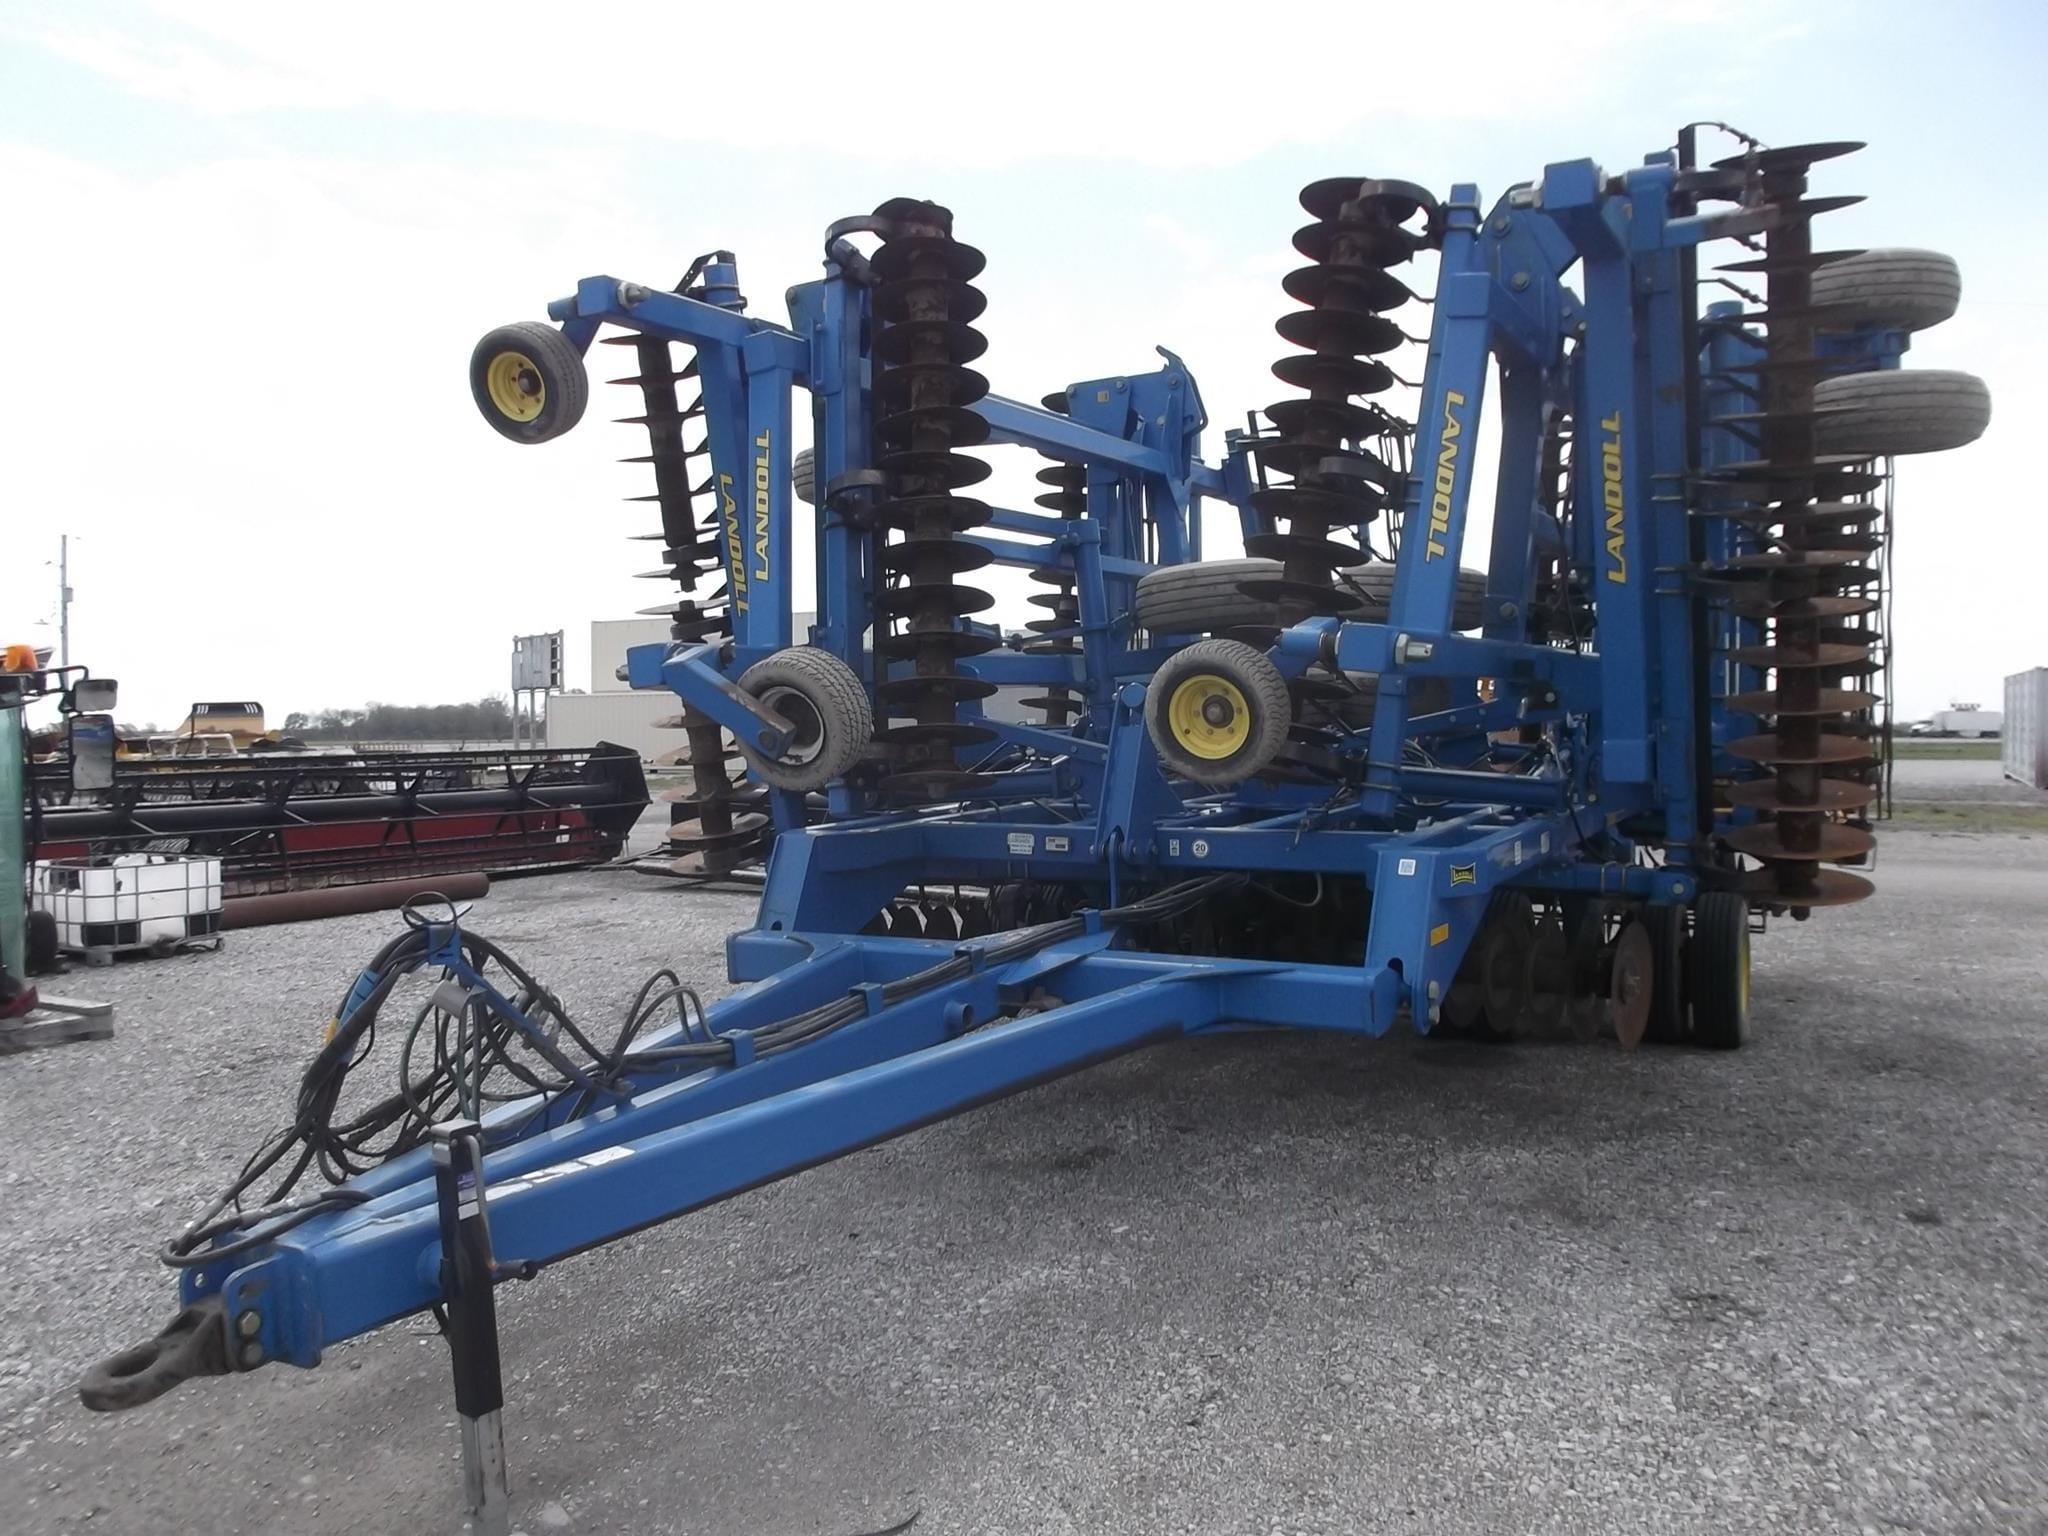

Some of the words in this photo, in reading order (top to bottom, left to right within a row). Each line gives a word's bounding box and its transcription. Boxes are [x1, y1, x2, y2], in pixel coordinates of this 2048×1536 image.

[720, 473, 749, 618] LANDOLL
[755, 429, 770, 582] LANDOLL
[1426, 391, 1465, 563] LANDOLL
[1601, 411, 1627, 584] LANDOLL
[1194, 843, 1206, 852] 20
